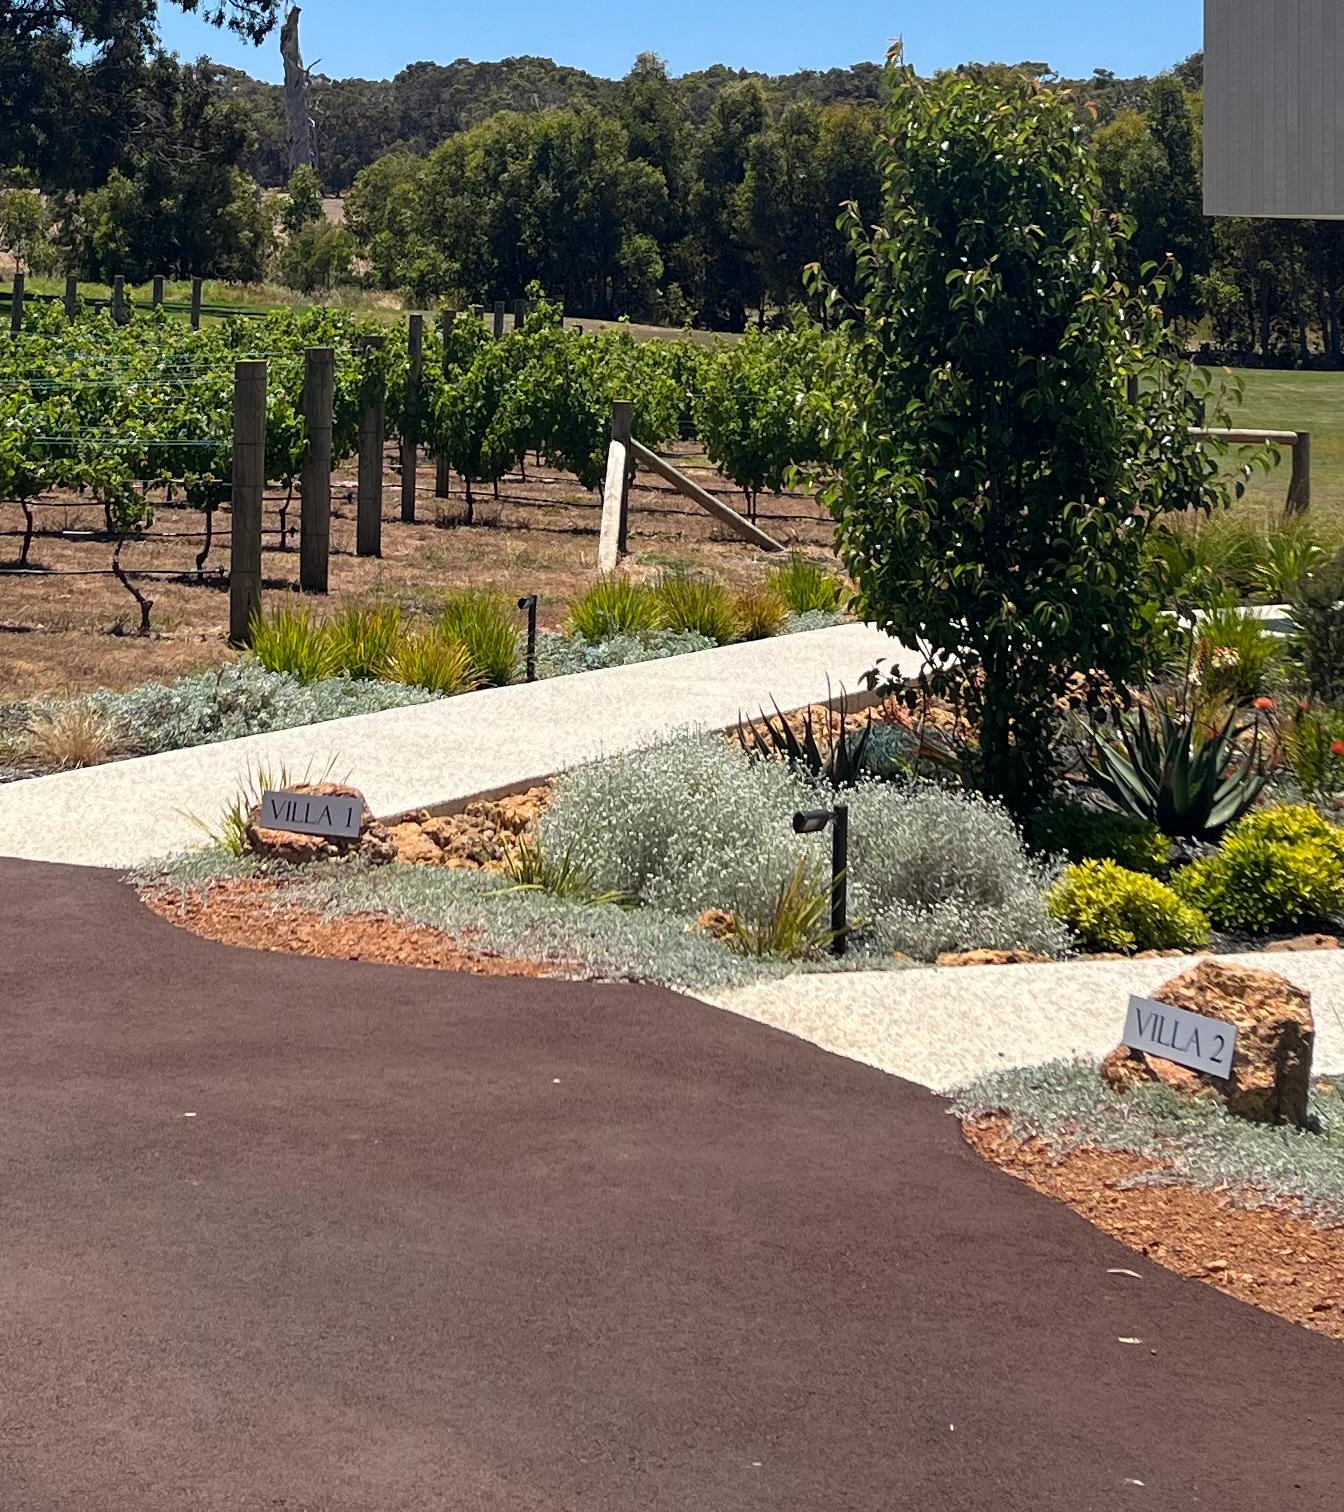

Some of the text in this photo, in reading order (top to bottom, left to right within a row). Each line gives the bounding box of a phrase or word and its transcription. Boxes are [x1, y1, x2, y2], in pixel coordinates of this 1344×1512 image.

[271, 799, 353, 828] VILLA 1
[1136, 1007, 1225, 1064] VILLA 2
